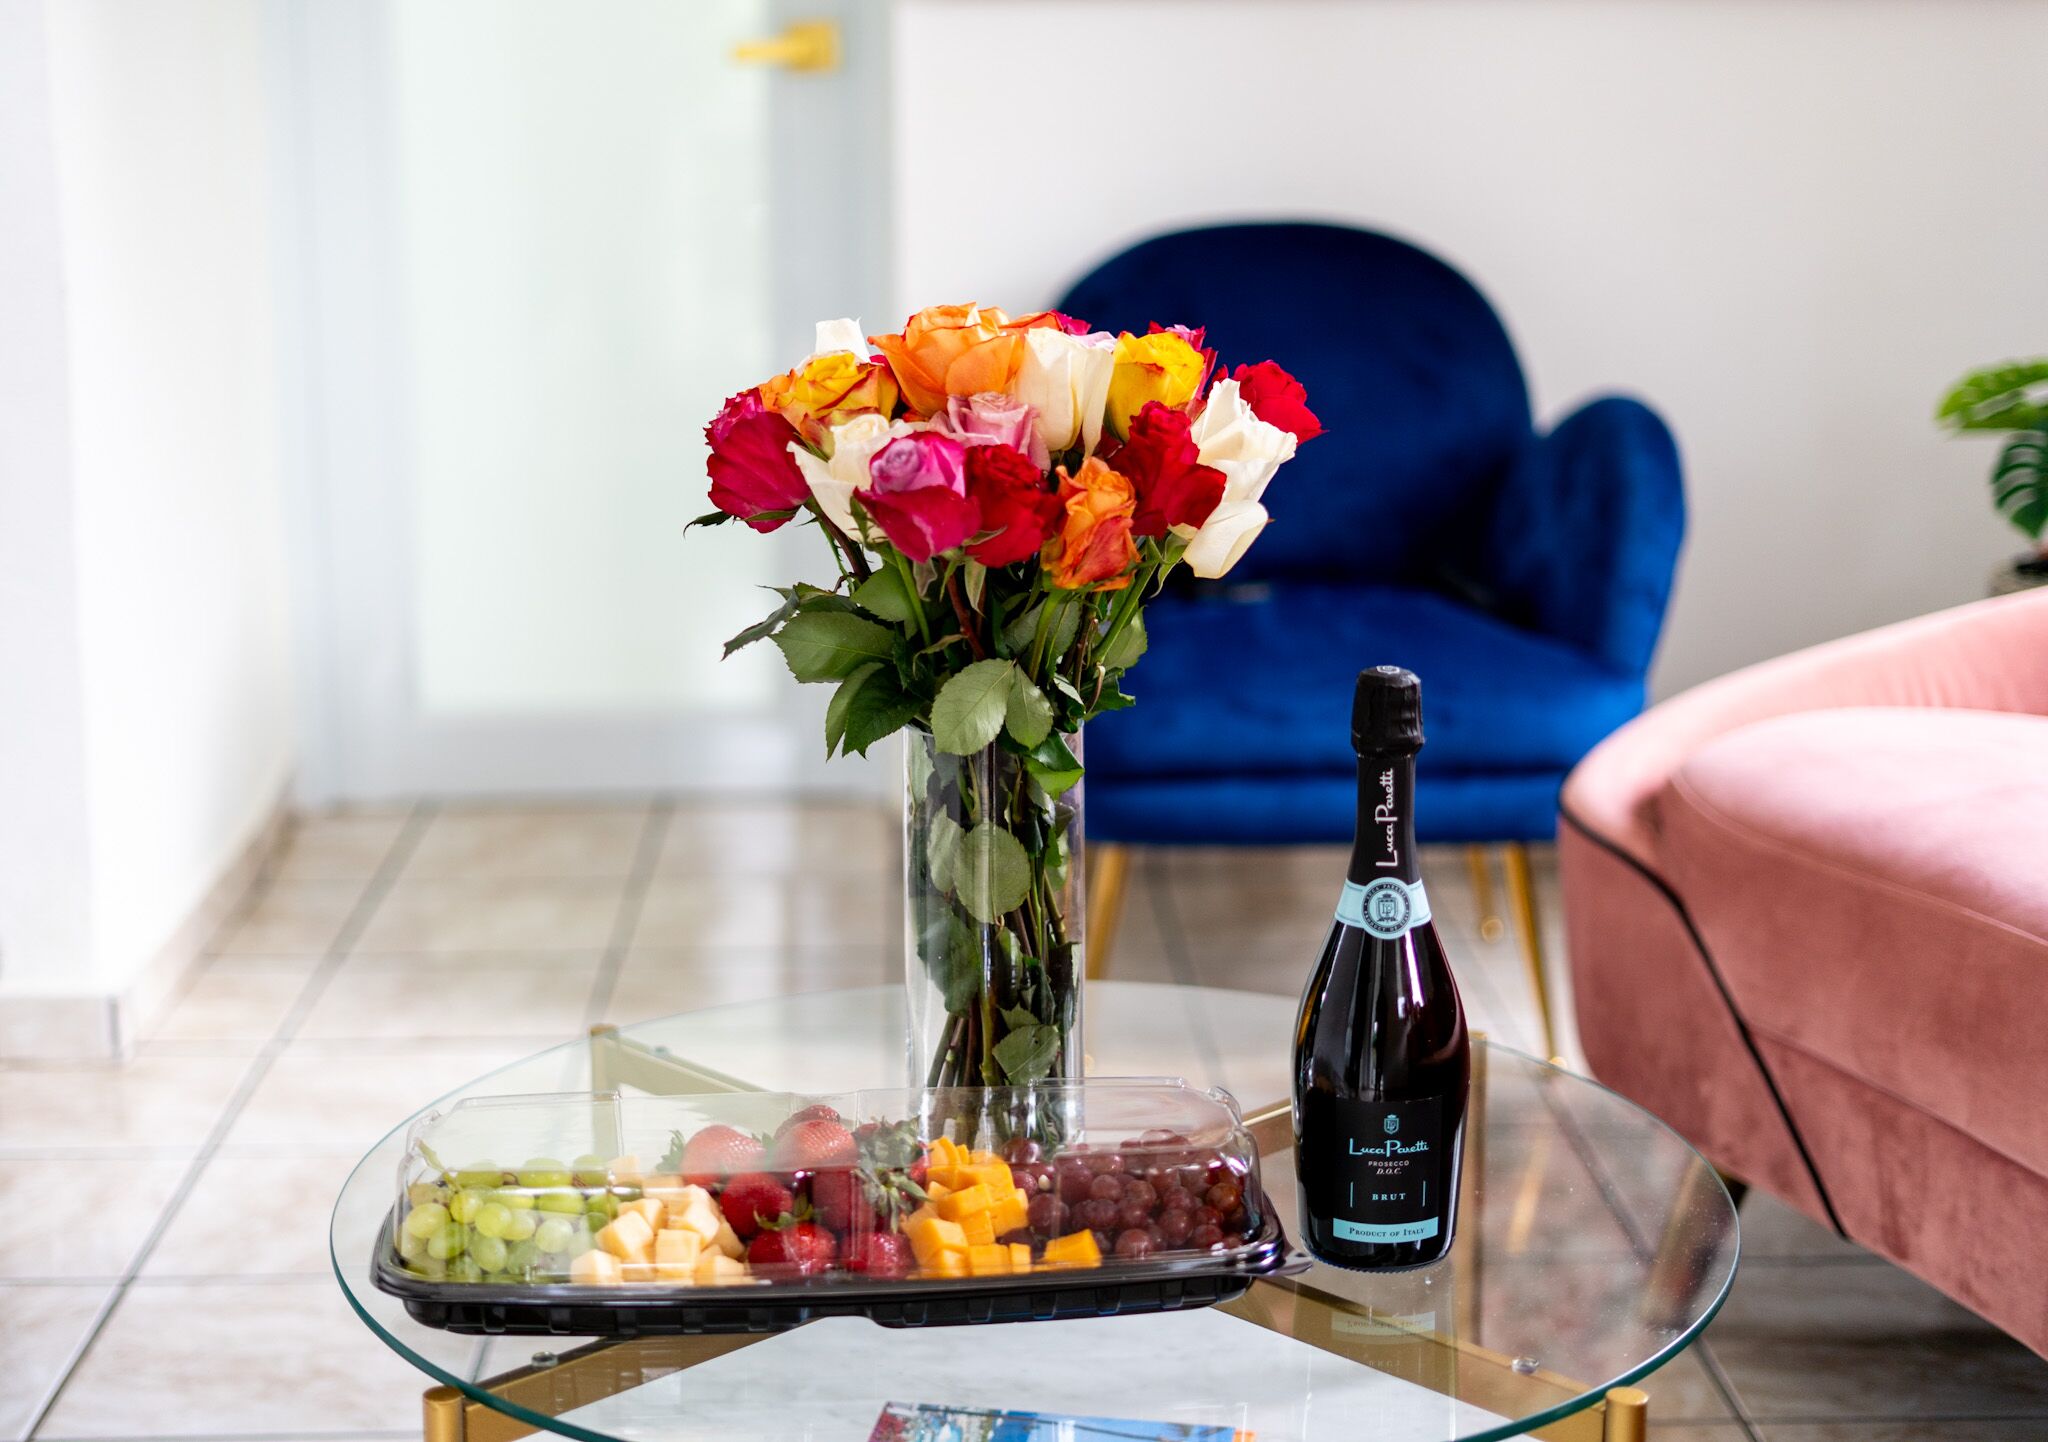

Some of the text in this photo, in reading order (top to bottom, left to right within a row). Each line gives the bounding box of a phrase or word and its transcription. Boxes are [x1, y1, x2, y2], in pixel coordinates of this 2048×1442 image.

[1374, 768, 1398, 867] Luca Paretti
[1349, 1138, 1430, 1158] Luca Paretti
[1376, 1167, 1402, 1175] D.O.C.
[1372, 1192, 1407, 1201] BRUT
[1349, 1227, 1387, 1238] PRODUCT
[1403, 1227, 1425, 1237] ITALY
